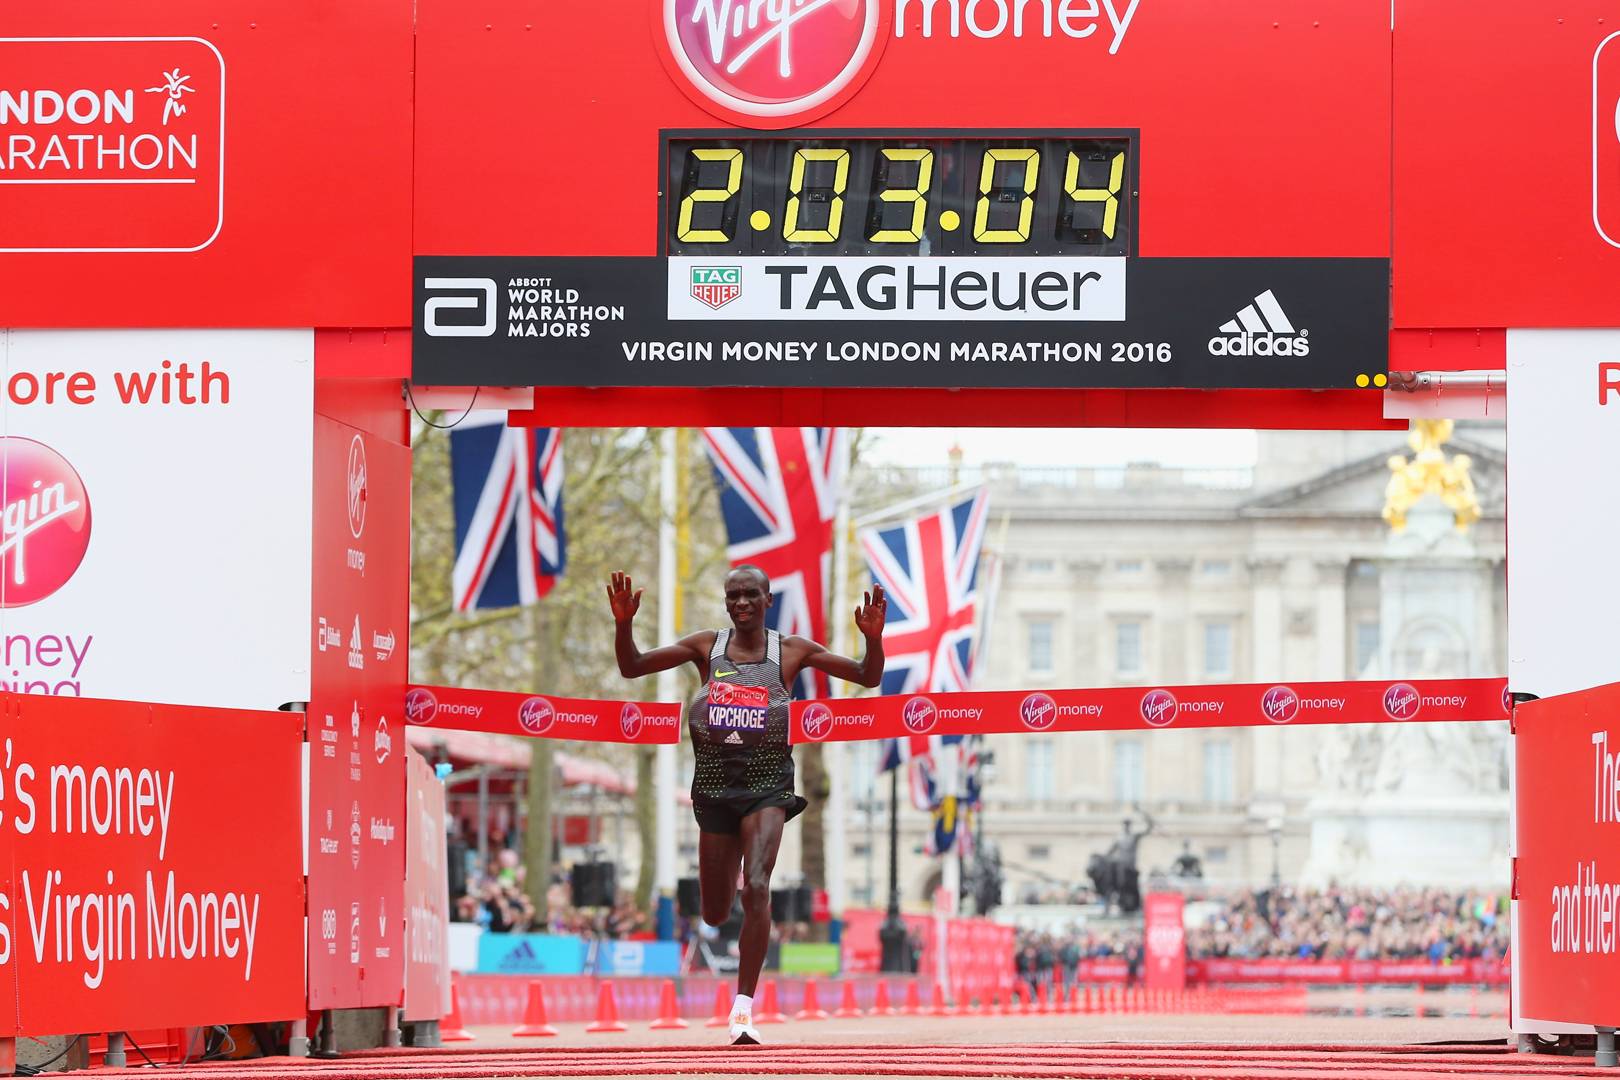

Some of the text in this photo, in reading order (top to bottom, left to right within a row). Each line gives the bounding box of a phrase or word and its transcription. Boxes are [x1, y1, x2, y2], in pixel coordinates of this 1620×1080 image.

[895, 0, 1140, 55] money
[0, 89, 134, 125] NDON
[0, 134, 197, 170] RATHON
[677, 148, 1125, 242] 2.03.04
[508, 278, 552, 287] ABBOTT
[695, 270, 736, 282] TAG
[765, 265, 1101, 311] TAGHeuer
[508, 289, 579, 304] WORLD
[695, 286, 738, 304] HEUER
[508, 306, 625, 321] MARATHON
[508, 323, 591, 338] MAJORS
[1208, 331, 1309, 356] adidas
[621, 342, 1172, 363] VIRGIN MONEY LONDON MARATHON 2016
[7, 360, 230, 405] ore with
[0, 481, 79, 584] gin
[0, 635, 93, 678] ney
[407, 693, 483, 719] Virgin money
[734, 690, 765, 701] money
[1145, 693, 1224, 720] Virgin money
[1266, 689, 1345, 717] Virgin money
[1387, 686, 1467, 714] Virgin money
[523, 702, 598, 728] Virgin money
[623, 708, 678, 733] Virgin money
[709, 706, 765, 728] KIPCHOGE
[804, 707, 875, 733] Virgin money
[906, 700, 983, 727] Virgin money
[1024, 697, 1103, 725] Virgin money
[50, 764, 174, 861] money
[1551, 860, 1620, 954] and ther
[22, 870, 136, 989] Virgin
[146, 870, 260, 981] Money
